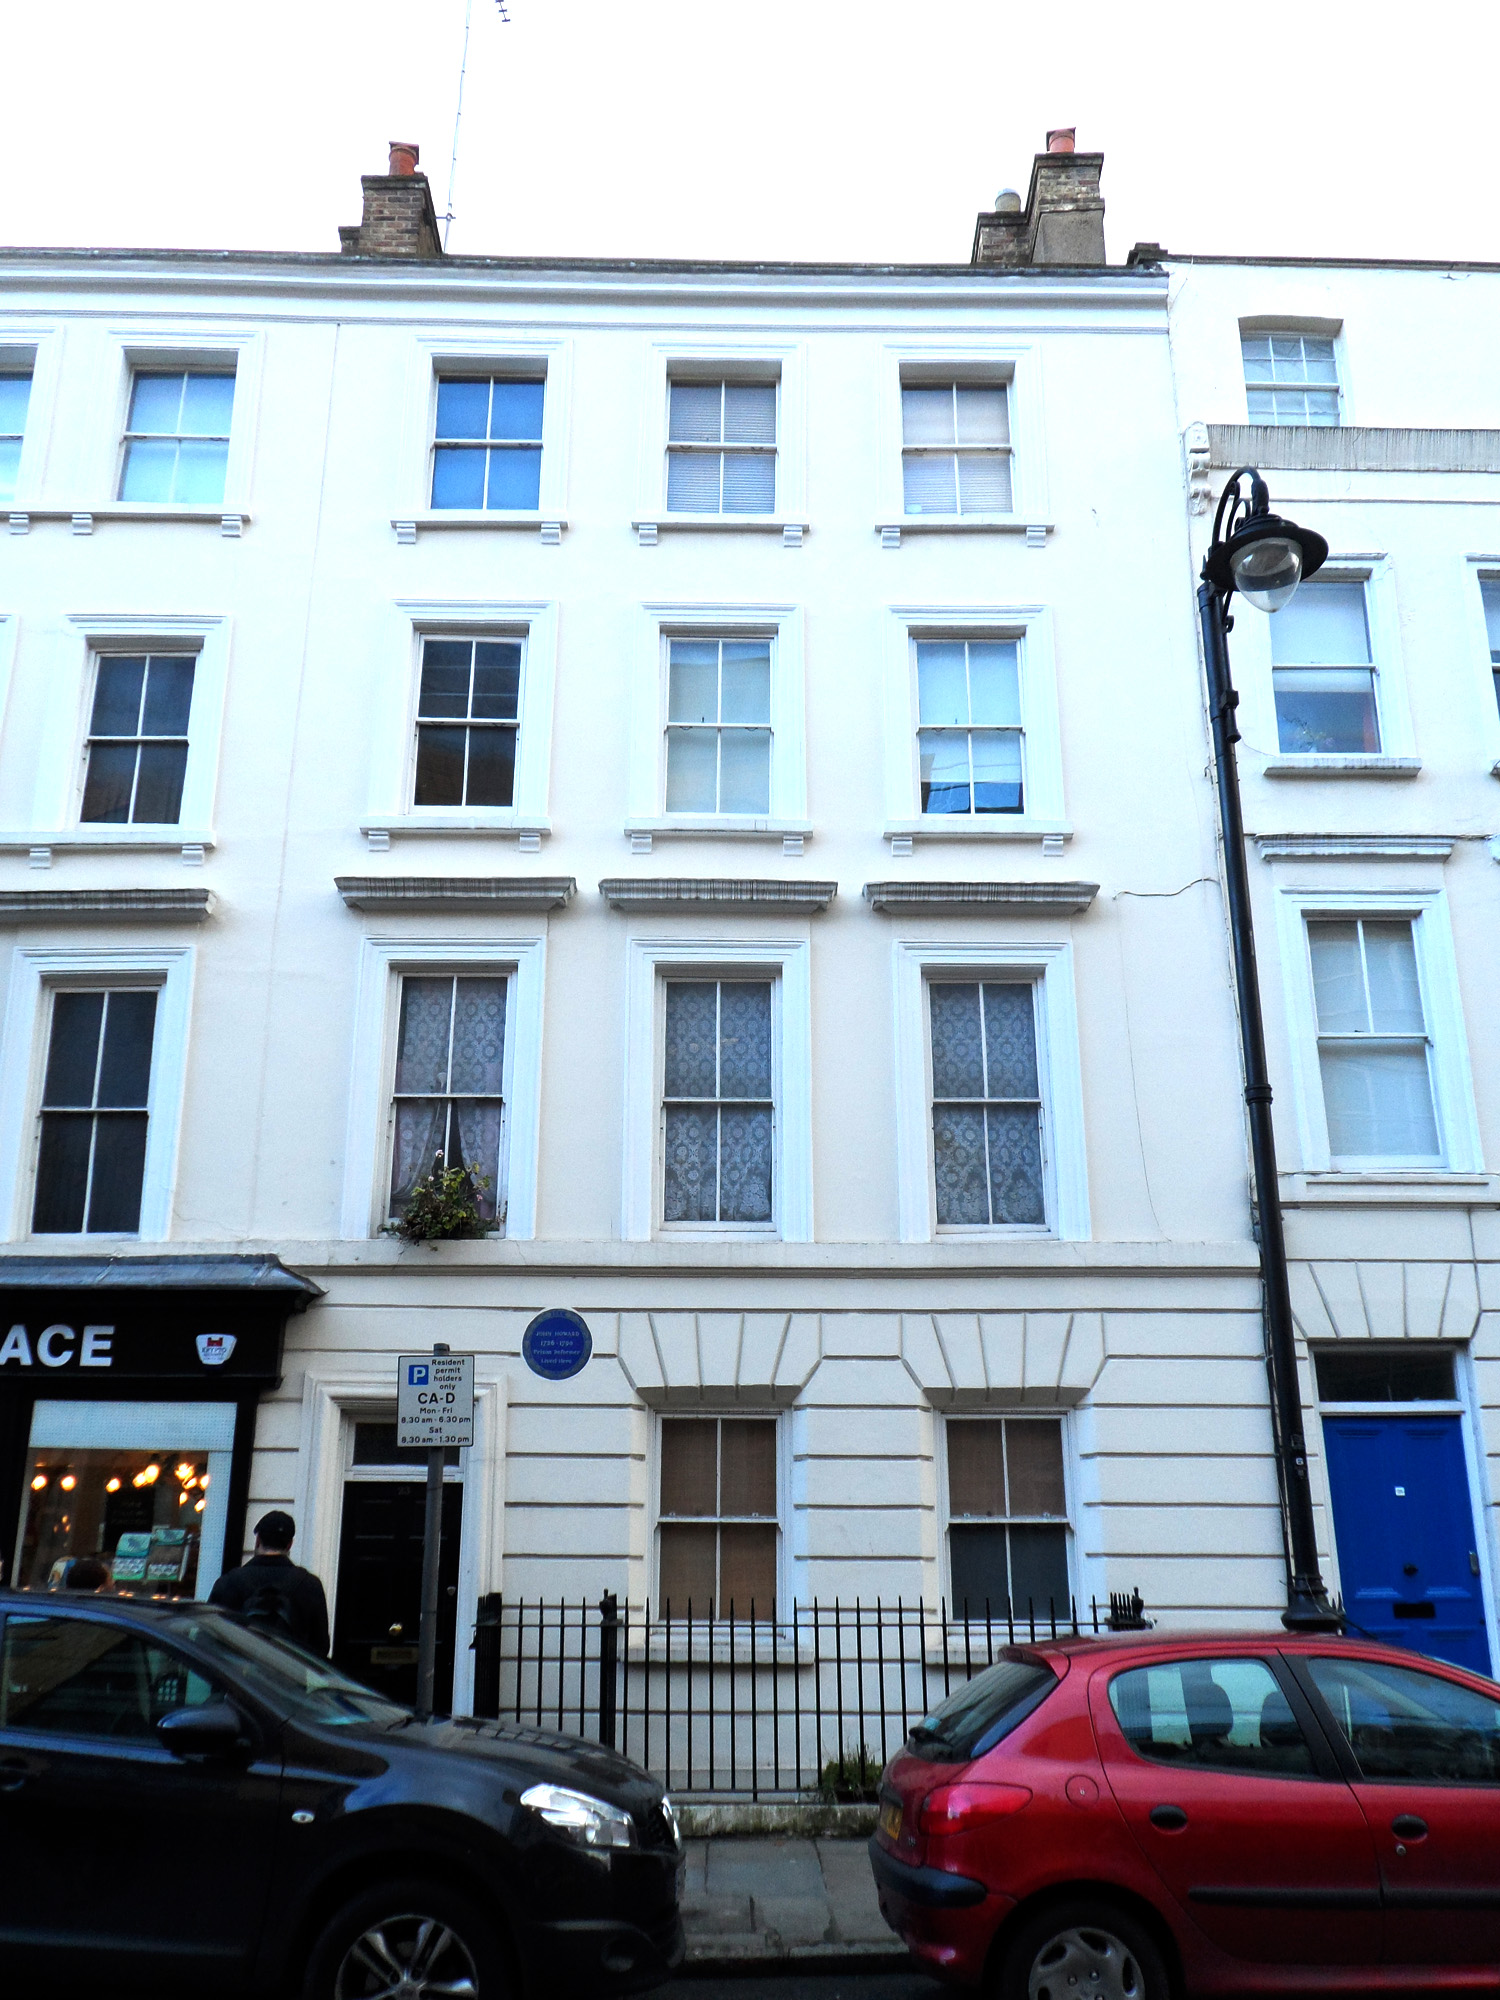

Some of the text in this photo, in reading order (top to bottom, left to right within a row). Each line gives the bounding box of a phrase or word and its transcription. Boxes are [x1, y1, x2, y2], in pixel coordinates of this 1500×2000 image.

[0, 1323, 116, 1368] ACE
[413, 1366, 426, 1384] P
[435, 1367, 461, 1375] permit
[439, 1383, 456, 1391] only
[401, 1416, 420, 1424] 8.30
[438, 1415, 458, 1423] 6.30
[428, 1426, 442, 1434] Sat
[401, 1436, 420, 1444] 8.30
[439, 1435, 456, 1443] 1.30
